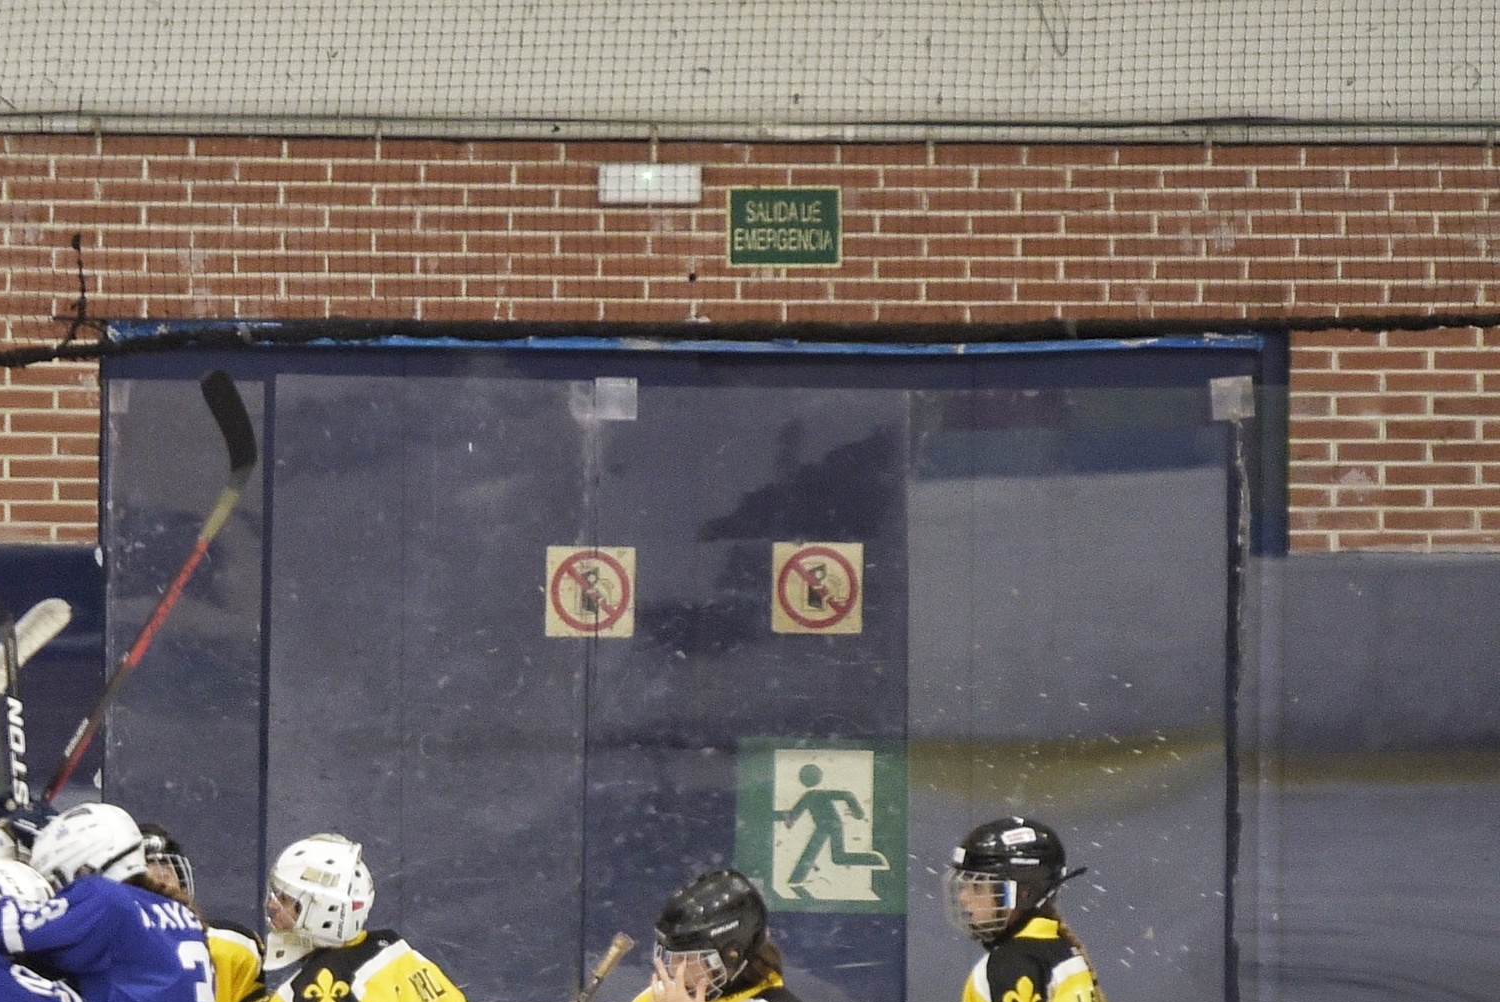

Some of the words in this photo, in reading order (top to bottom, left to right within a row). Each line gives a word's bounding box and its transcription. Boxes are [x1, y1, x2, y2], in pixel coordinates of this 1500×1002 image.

[745, 200, 798, 223] SALIDA
[801, 200, 823, 222] DE
[733, 227, 833, 251] EMERGENCIA
[6, 695, 30, 808] STON
